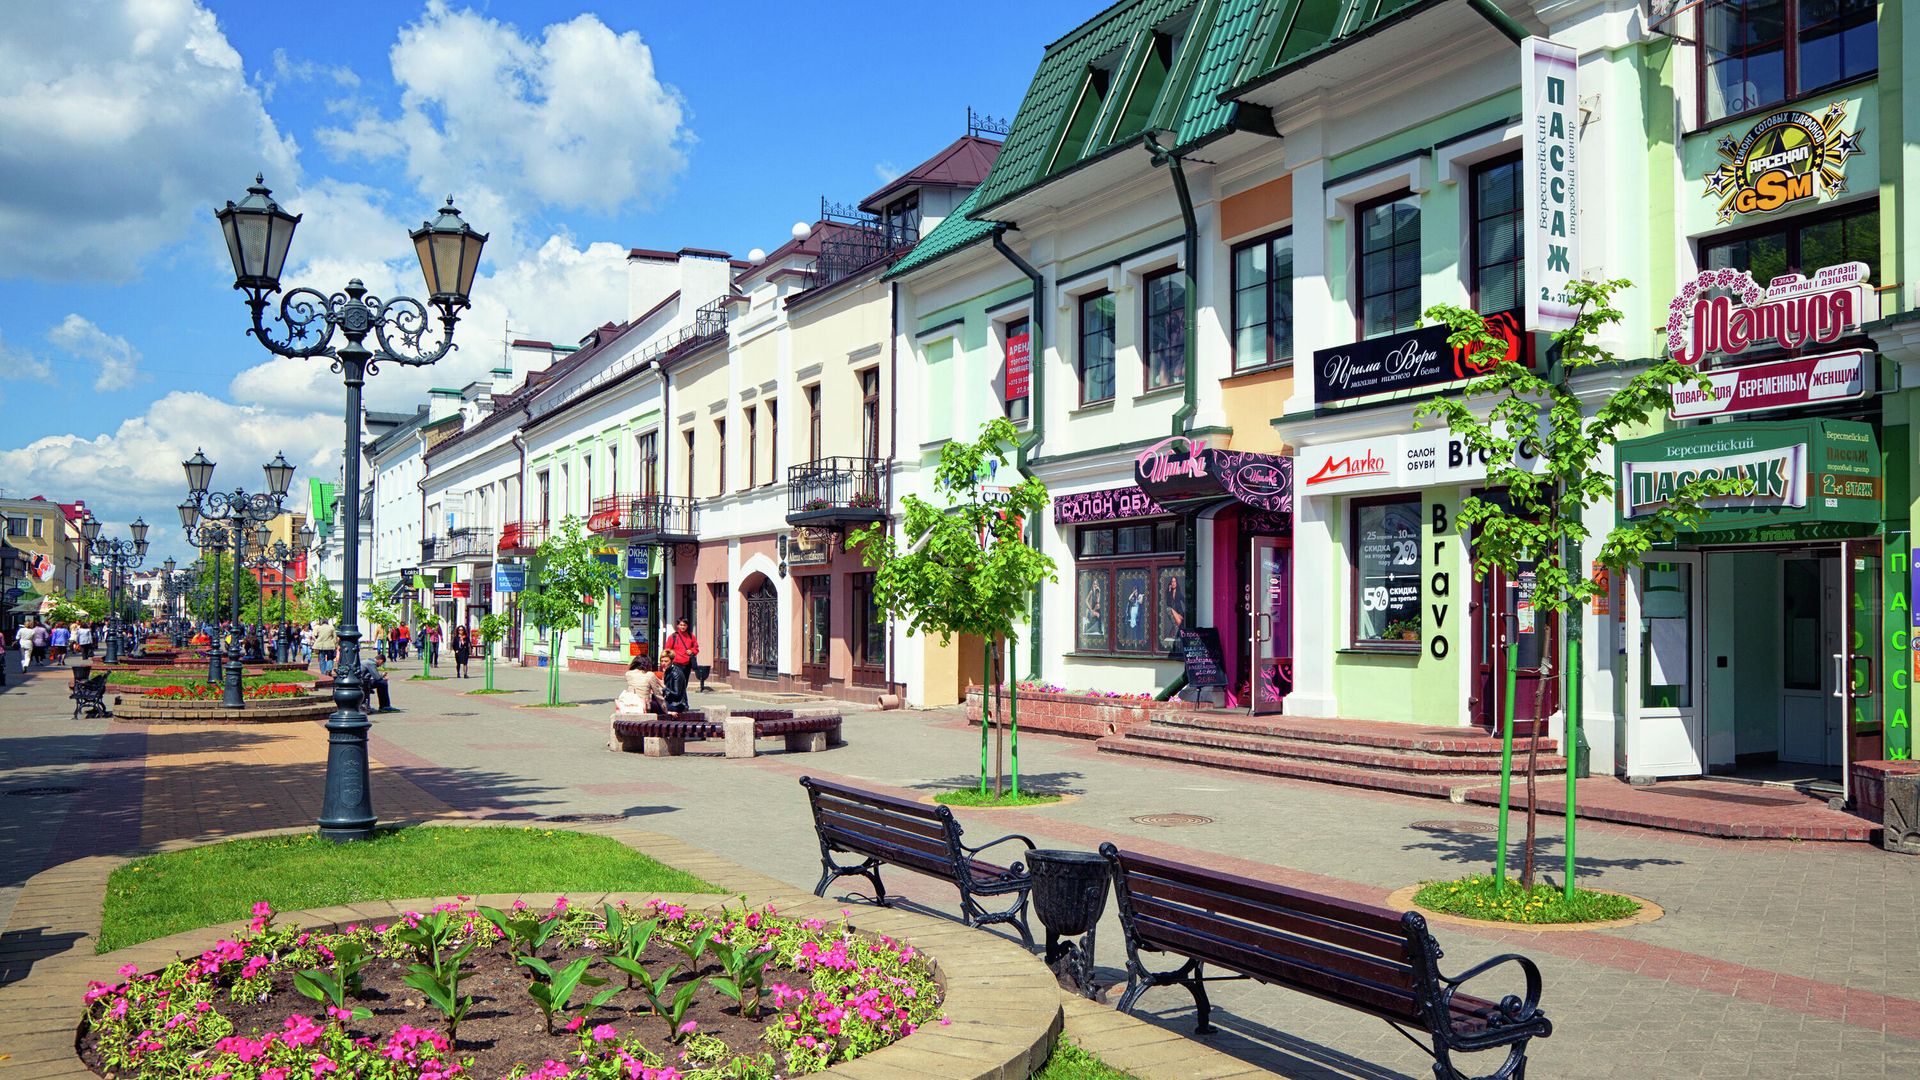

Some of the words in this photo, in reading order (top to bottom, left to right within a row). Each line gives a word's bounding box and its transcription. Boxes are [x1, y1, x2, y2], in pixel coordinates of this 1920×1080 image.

[1568, 121, 1577, 163] центр
[1734, 135, 1755, 165] РЕМОНТ
[1754, 112, 1789, 134] СОТОВЫХ
[1791, 112, 1826, 143] ТЕЛЕФОНОВ
[1537, 115, 1549, 229] Берестейский
[1750, 146, 1810, 174] АРСЕНАЛ
[1547, 76, 1570, 274] ПАССАЖ
[1567, 170, 1578, 235] торговый
[1735, 171, 1813, 211] GSM
[1769, 286, 1787, 297] ДЛЯ
[1324, 354, 1382, 389] Прима
[1385, 339, 1438, 377] Вера
[1350, 378, 1378, 389] магазин
[1381, 372, 1411, 383] нижнего
[1420, 366, 1441, 376] белья
[1714, 385, 1732, 401] ДЛЯ
[1739, 372, 1807, 398] БЕРЕМЕННЫХ
[1812, 367, 1859, 387] ЖЕНЩИН
[1666, 437, 1754, 458] Берестейский
[1826, 431, 1869, 443] Берестейский
[1407, 447, 1435, 459] САЛОН
[1408, 460, 1435, 471] ОБУВИ
[1449, 438, 1539, 468] Brao
[1826, 447, 1869, 464] ПАССАЖ
[1306, 448, 1390, 485] Marko
[1632, 457, 1787, 507] ПАССАЖ
[1845, 481, 1873, 497] ЭТАЖ
[1062, 498, 1113, 518] САЛОН
[1120, 494, 1150, 511] ОБУ
[1366, 531, 1377, 540] 25
[1398, 530, 1408, 539] 10
[1749, 528, 1758, 542] 2
[1760, 529, 1796, 541] этаж
[629, 548, 648, 557] ОКНА
[1364, 545, 1391, 553] СКИДКА
[1389, 587, 1417, 596] СКИДКА
[1430, 504, 1449, 660] Bravo
[1889, 553, 1911, 760] ПАССАЖ
